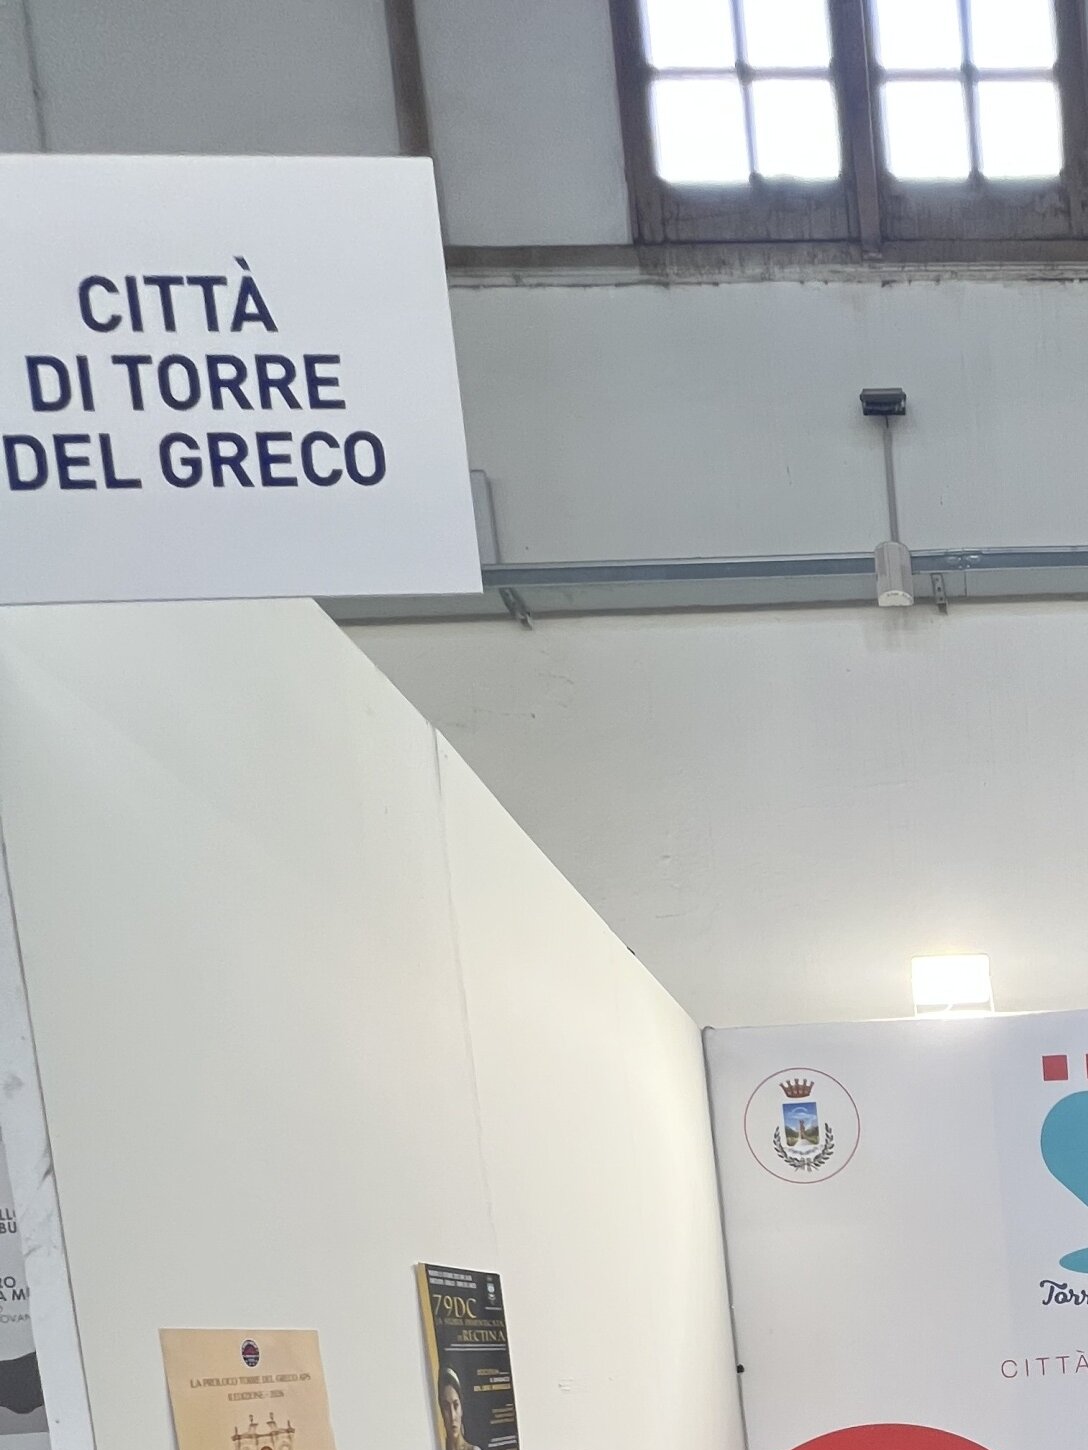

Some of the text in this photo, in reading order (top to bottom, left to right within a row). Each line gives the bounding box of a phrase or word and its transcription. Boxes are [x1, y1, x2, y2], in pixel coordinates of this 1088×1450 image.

[79, 255, 278, 333] CITTÀ
[25, 354, 346, 411] DI TORRE
[3, 430, 387, 490] DEL GRECO
[432, 1294, 477, 1319] 79DC
[462, 1330, 506, 1342] RECTINA
